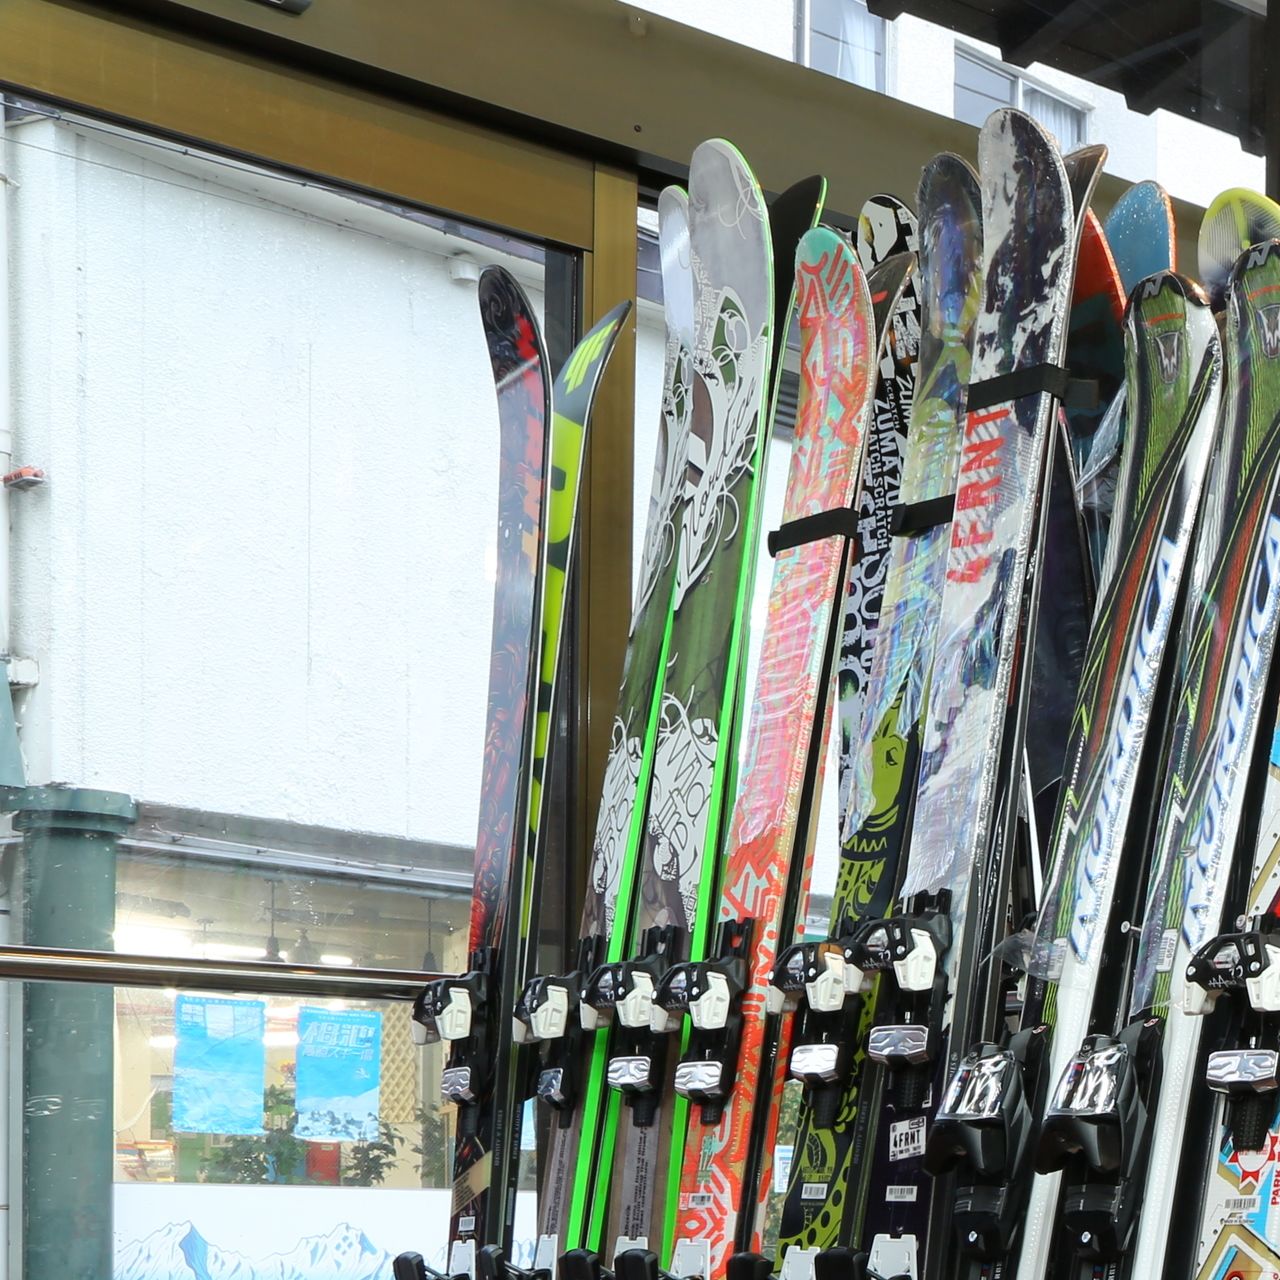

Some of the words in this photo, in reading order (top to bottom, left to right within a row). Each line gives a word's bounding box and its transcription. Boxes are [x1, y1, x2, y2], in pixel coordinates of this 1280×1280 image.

[873, 399, 896, 472] ZUMA
[885, 380, 901, 429] SCRATCH
[872, 477, 888, 551] SCRATCH
